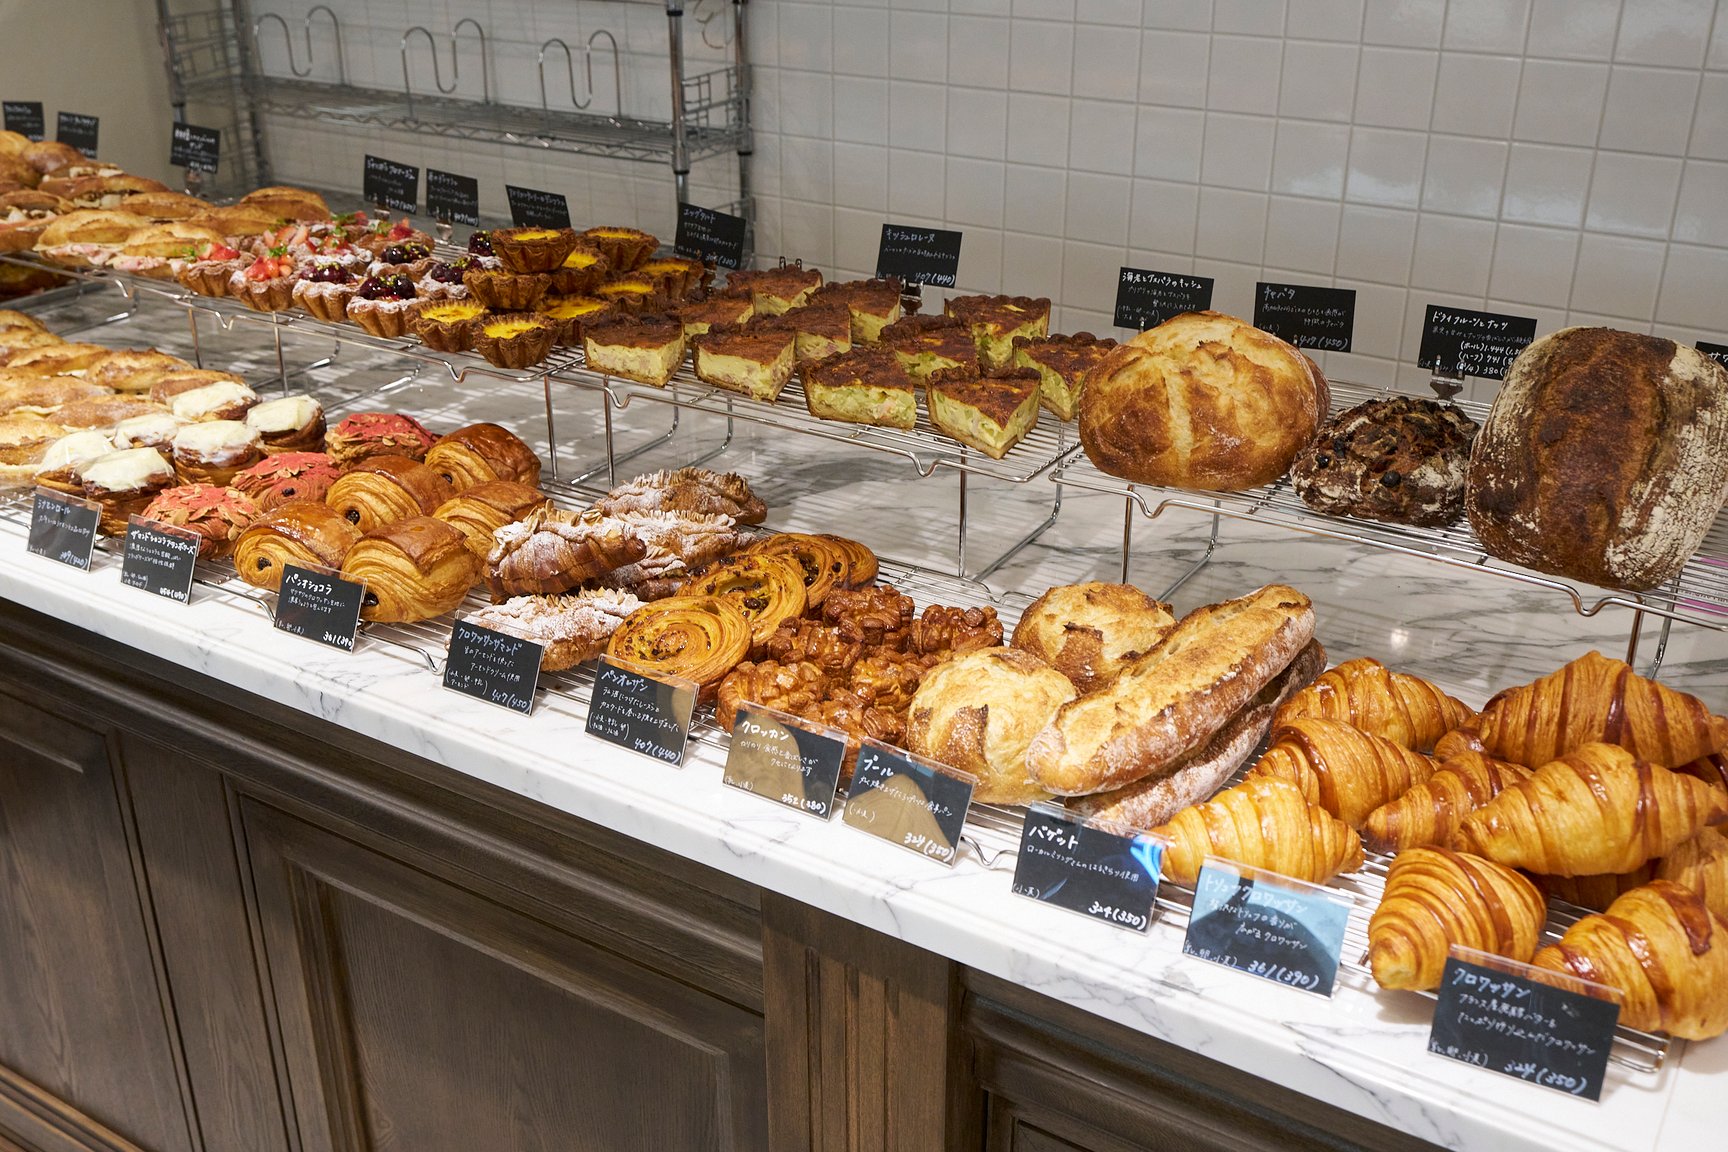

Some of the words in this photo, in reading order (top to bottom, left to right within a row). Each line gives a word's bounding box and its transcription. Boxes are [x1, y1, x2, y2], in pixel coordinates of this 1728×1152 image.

[1122, 271, 1202, 289] 海老とアスパラのキッシュ
[1432, 310, 1509, 330] ドライフルーツとナッツ
[1300, 335, 1348, 351] 417(450)
[286, 573, 332, 595] パンオショコラ
[323, 631, 354, 650] 361(390)
[742, 720, 789, 741] クロッカン
[635, 738, 681, 764] 407(440)
[864, 754, 894, 777] ブール
[781, 793, 826, 815] 352(380)
[904, 832, 955, 862] 324(350)
[1028, 825, 1078, 850] バゲット
[1088, 901, 1147, 931] 324(350)
[1247, 960, 1320, 990] 361(390)
[1451, 967, 1531, 999] クロワッサン
[1504, 1061, 1588, 1094] 324(350)
